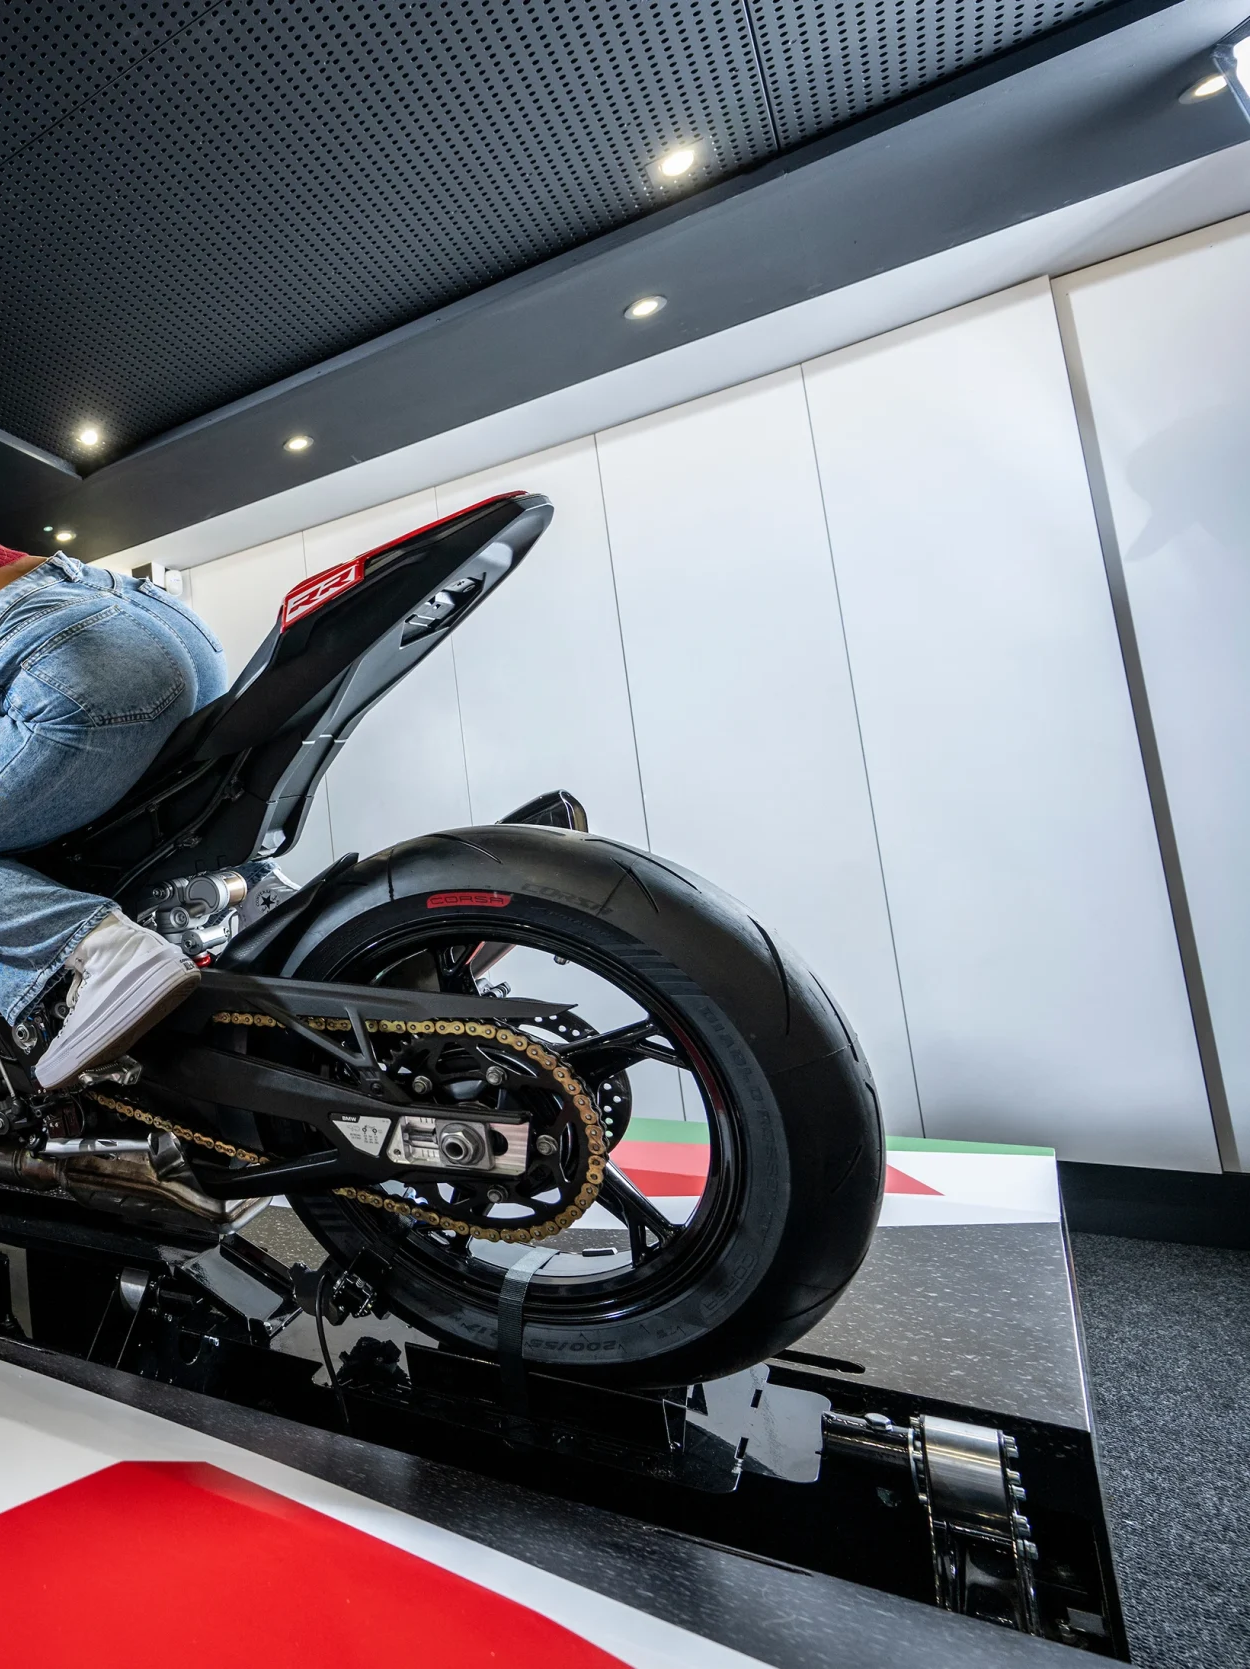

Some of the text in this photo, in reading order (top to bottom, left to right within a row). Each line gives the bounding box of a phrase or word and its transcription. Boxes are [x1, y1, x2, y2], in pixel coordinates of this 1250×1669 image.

[429, 894, 504, 906] CORSA
[703, 1253, 756, 1312] CORSA
[529, 1337, 617, 1352] 200/55
